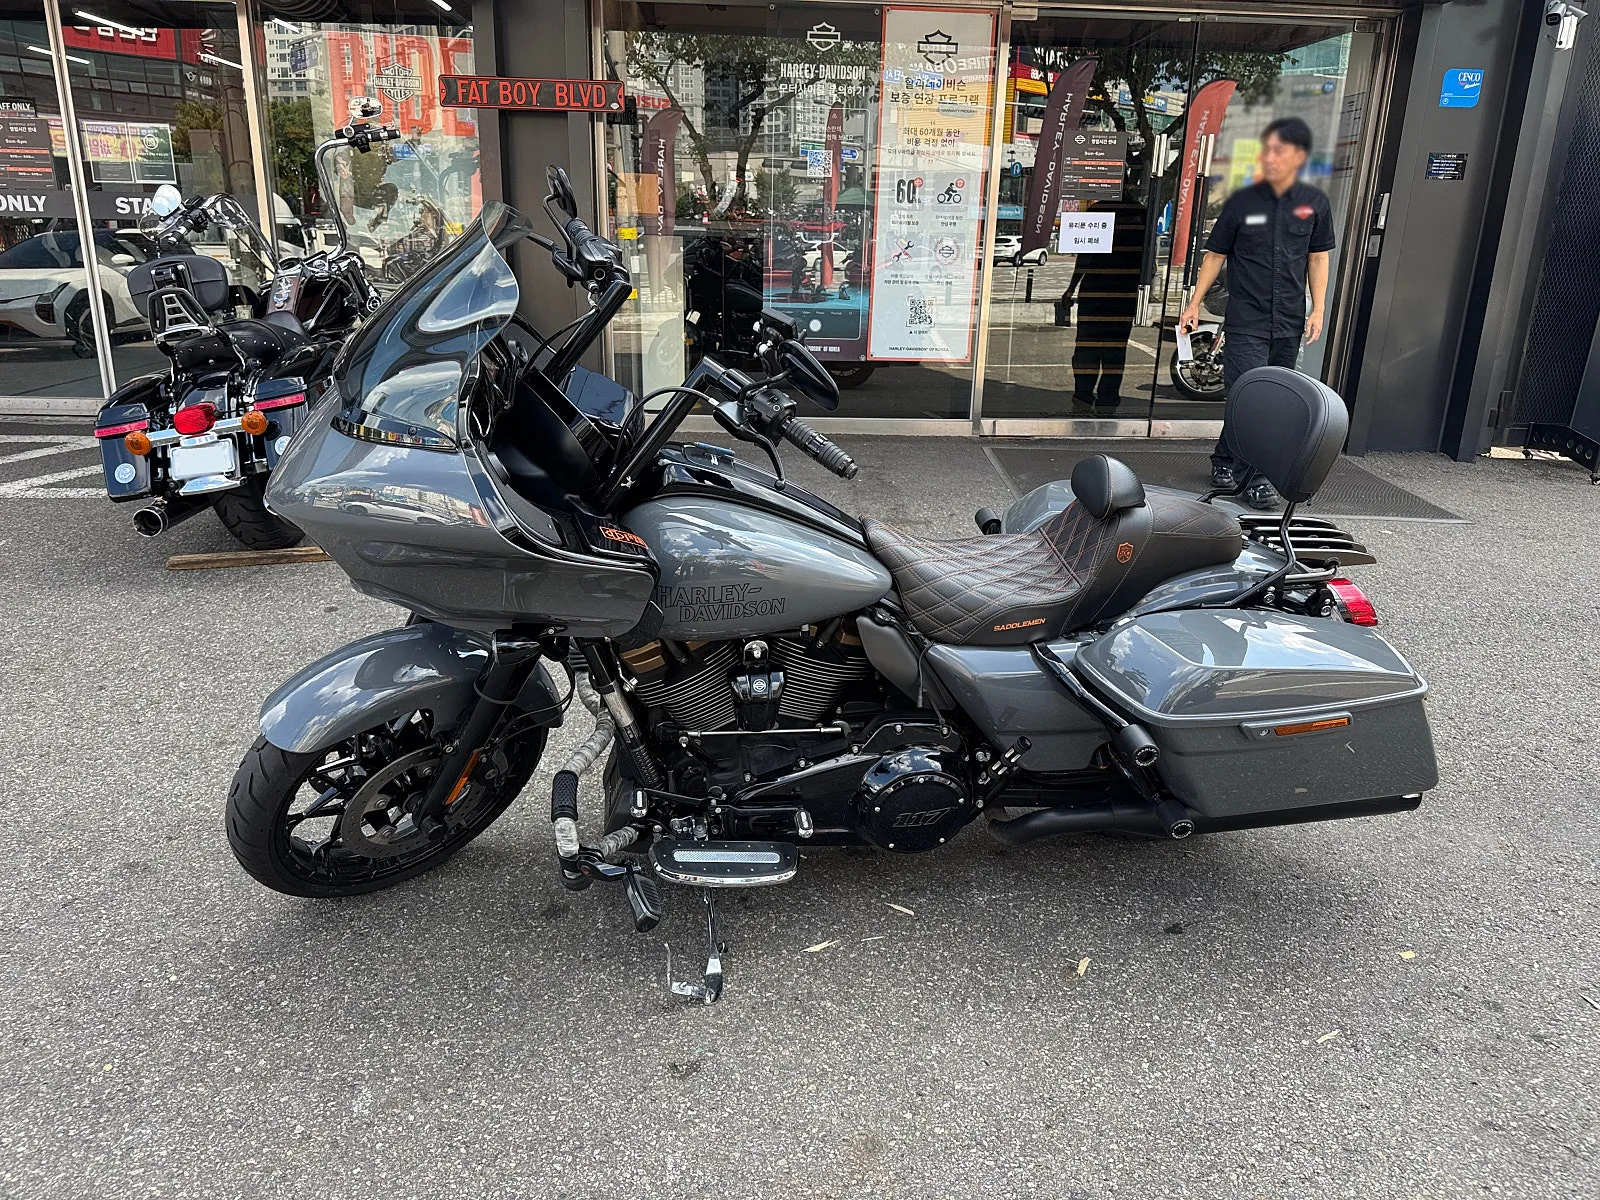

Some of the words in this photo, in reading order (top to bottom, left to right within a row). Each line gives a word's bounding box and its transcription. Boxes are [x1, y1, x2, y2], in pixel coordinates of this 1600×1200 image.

[780, 63, 866, 80] HARLEY-DAVIDSON
[457, 80, 490, 104] FAT
[500, 81, 541, 106] BOY
[555, 83, 606, 108] BLVD
[890, 92, 911, 104] 보증
[914, 92, 935, 105] 연장
[12, 102, 31, 111] ONLY
[1068, 222, 1086, 230] 유리문
[1088, 222, 1100, 230] 수리
[1101, 222, 1108, 230] 중
[1074, 237, 1086, 245] 임시
[680, 598, 786, 622] DAVIDSON
[993, 618, 1046, 632] SADDLEMEN
[892, 806, 952, 828] 117
